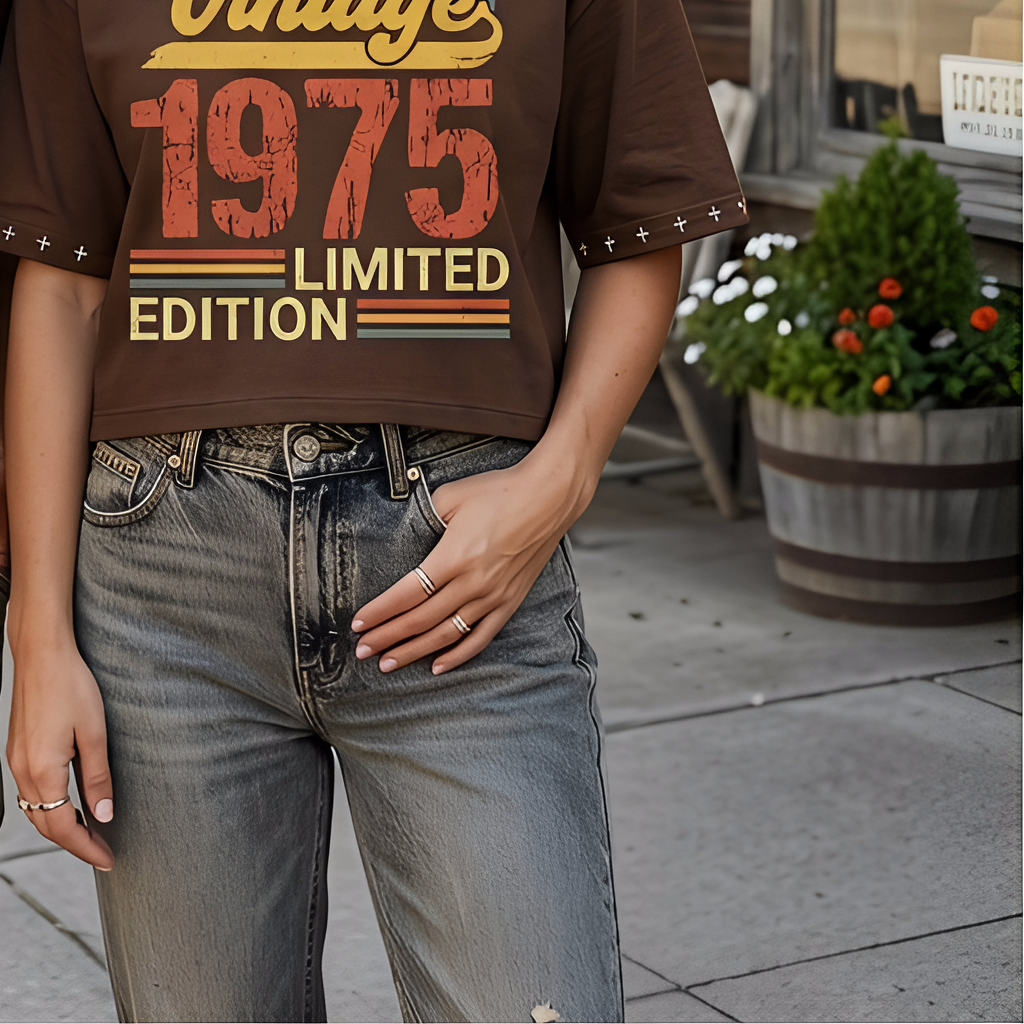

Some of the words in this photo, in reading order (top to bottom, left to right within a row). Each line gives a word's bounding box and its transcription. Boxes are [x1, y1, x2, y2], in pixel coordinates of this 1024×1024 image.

[130, 77, 500, 240] 1975
[294, 247, 511, 292] LIMITED
[129, 296, 347, 342] EDITION
